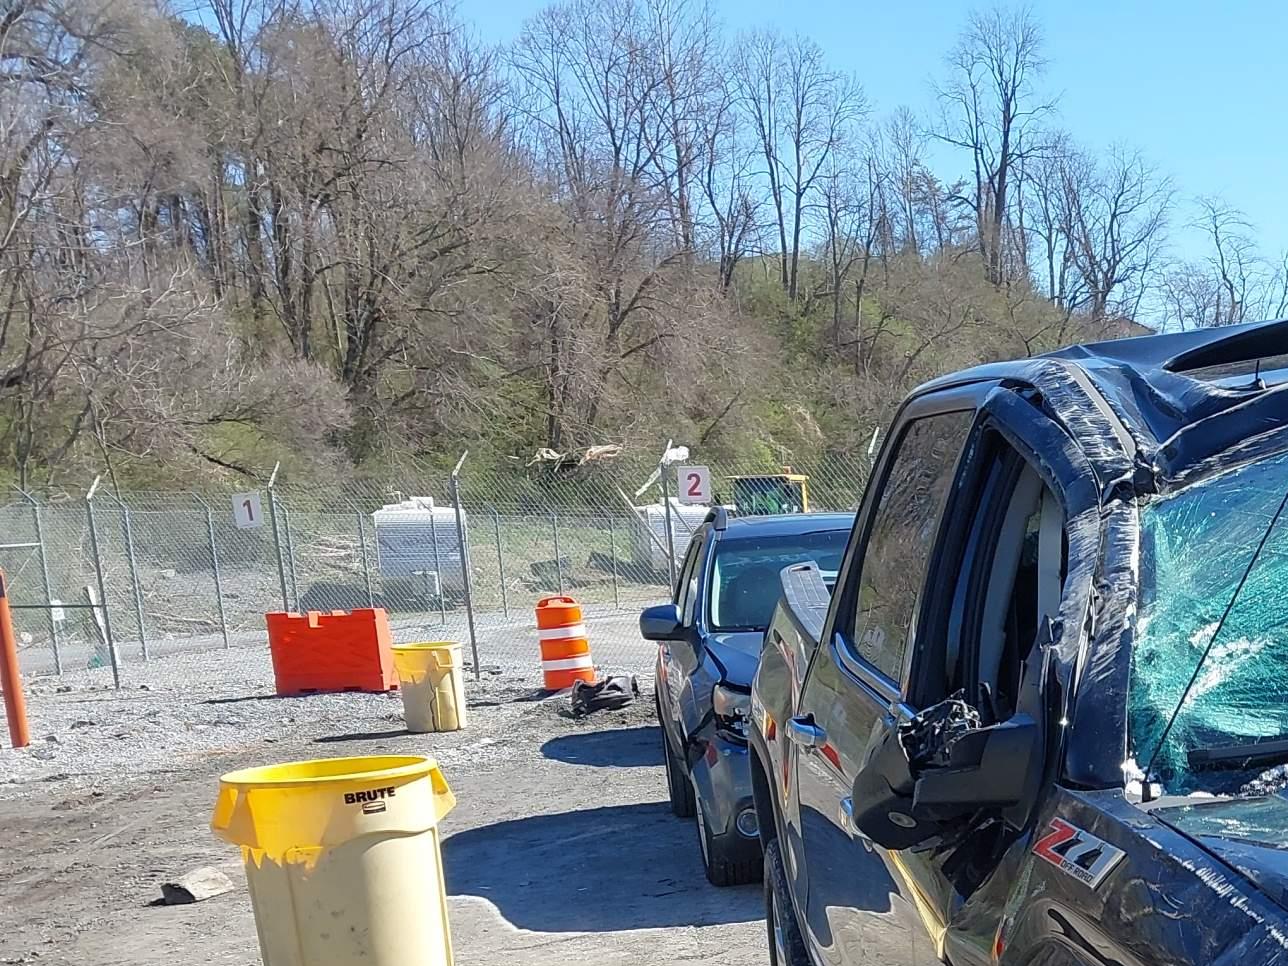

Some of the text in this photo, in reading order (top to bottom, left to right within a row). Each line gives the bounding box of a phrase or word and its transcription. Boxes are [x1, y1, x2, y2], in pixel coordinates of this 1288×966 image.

[687, 473, 702, 496] 2
[243, 500, 253, 521] 1
[344, 786, 396, 804] BRUTE
[1032, 816, 1127, 878] Z71
